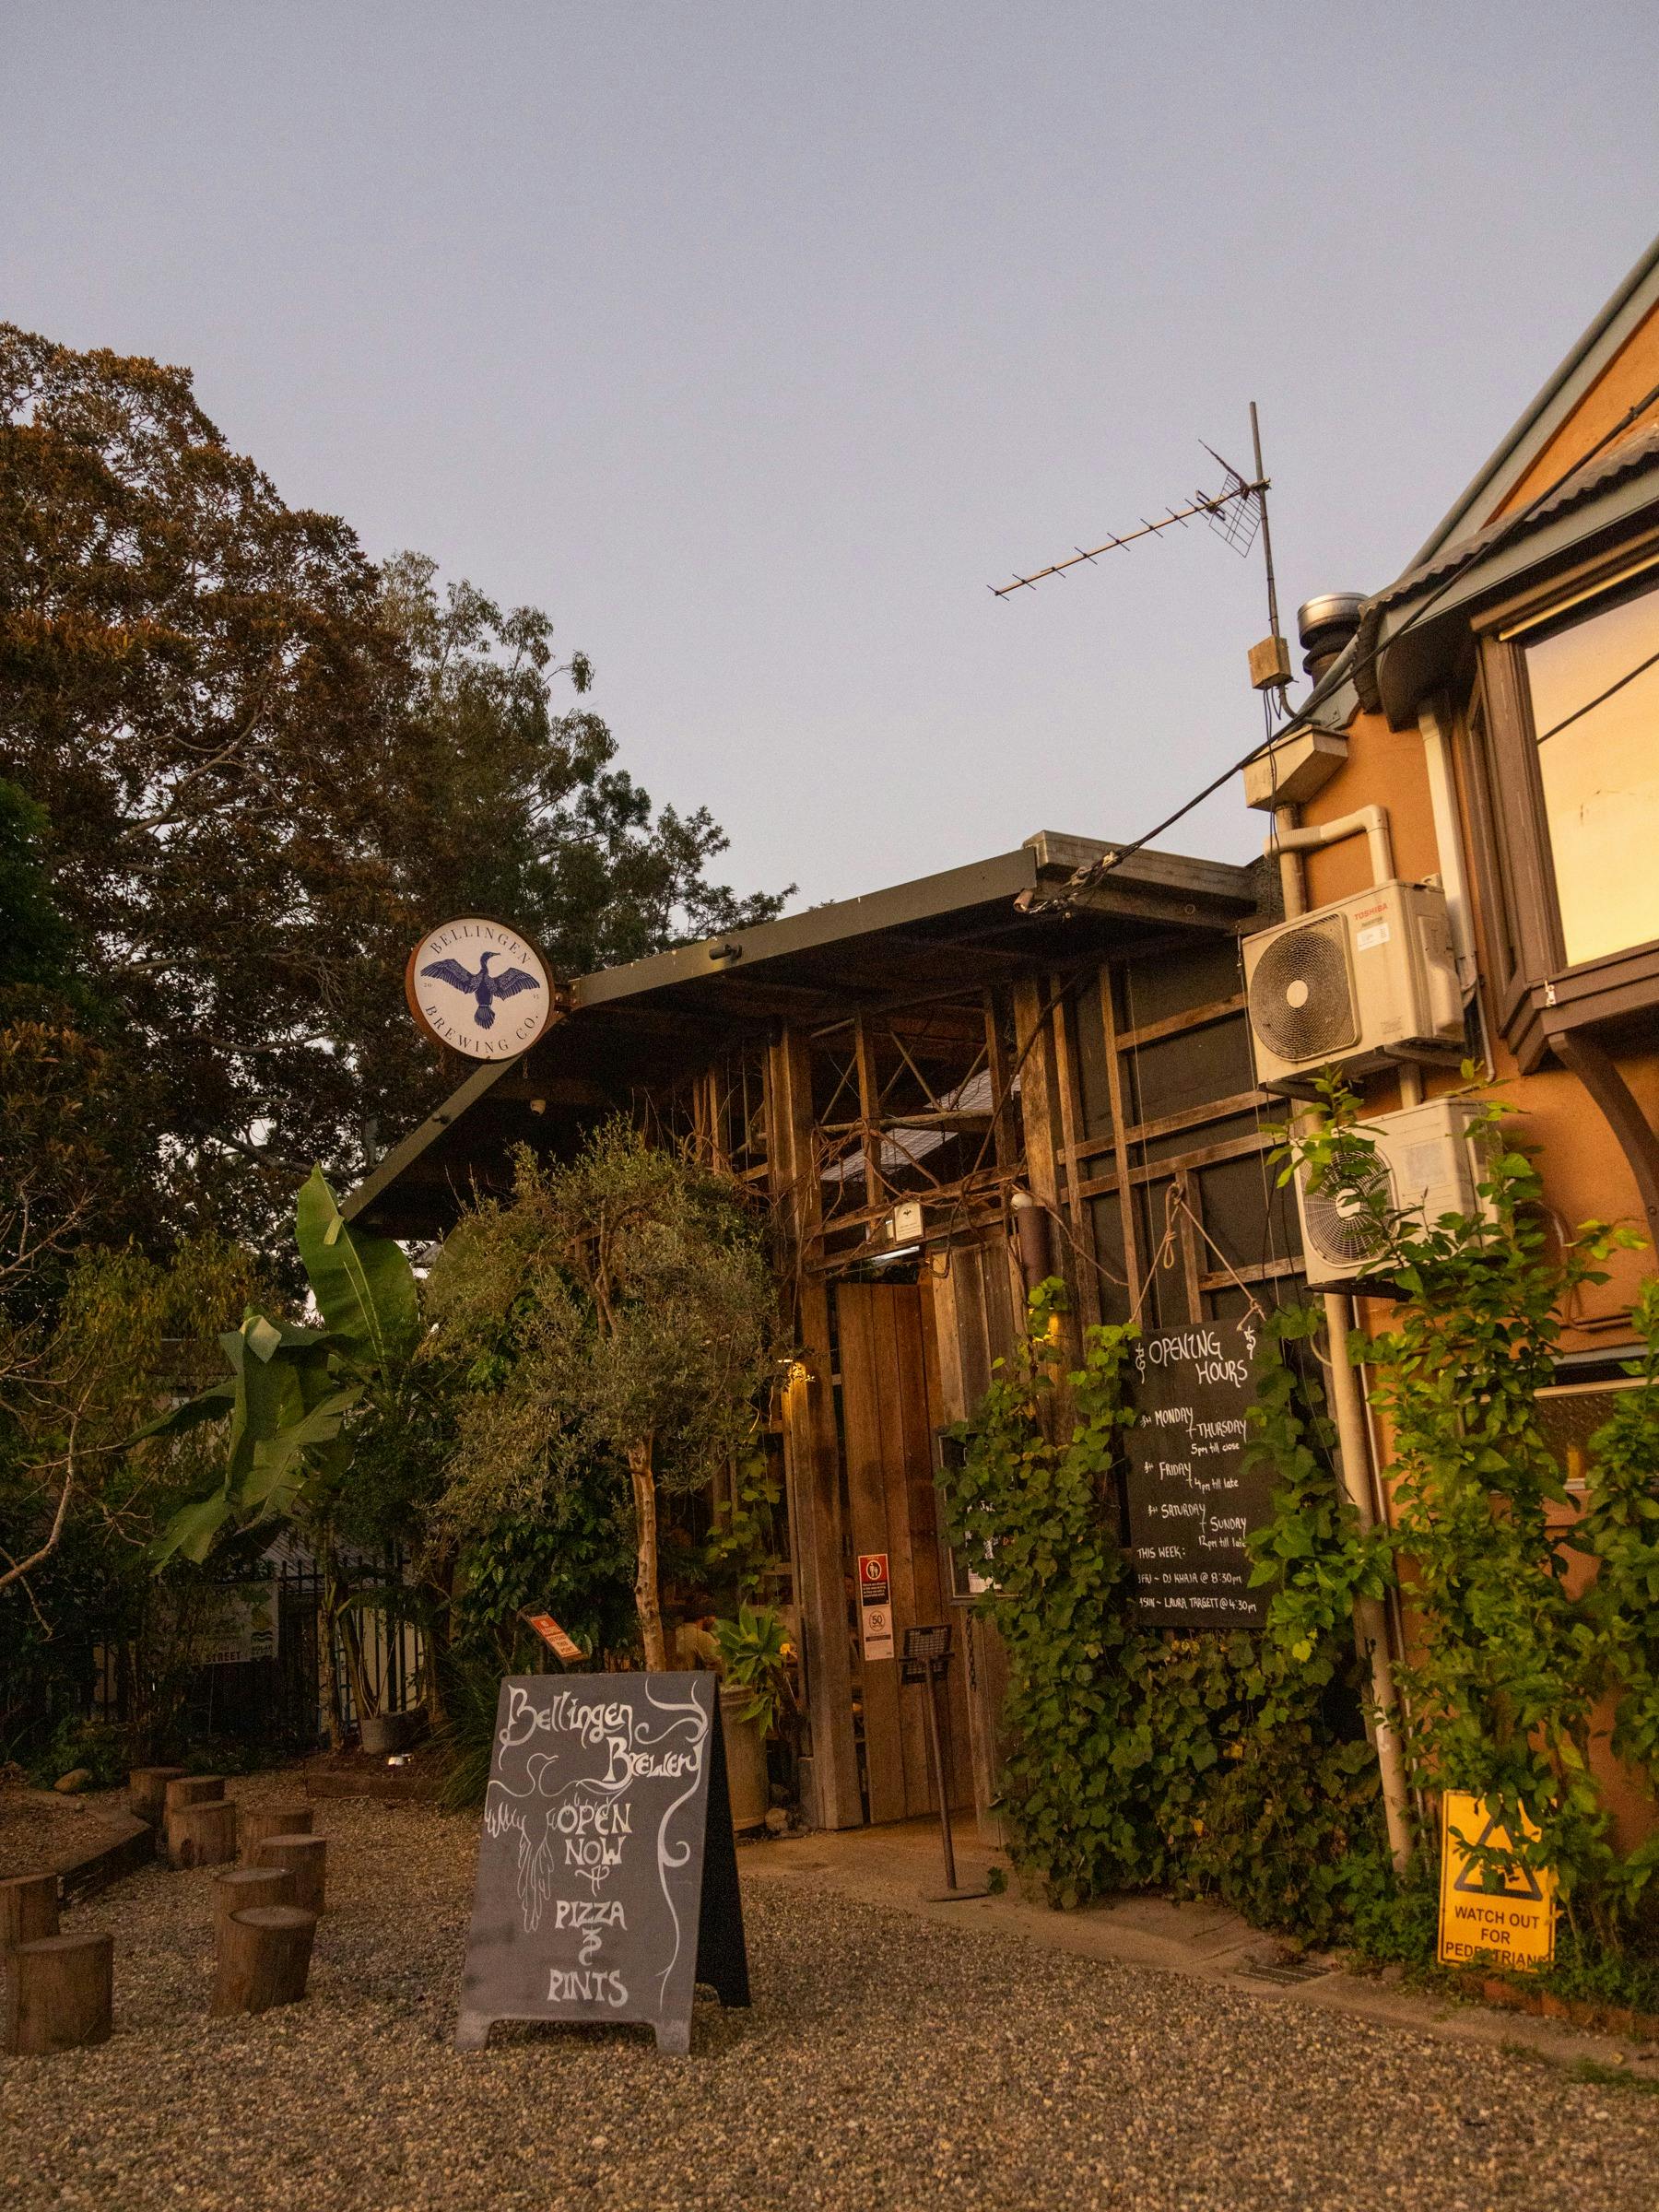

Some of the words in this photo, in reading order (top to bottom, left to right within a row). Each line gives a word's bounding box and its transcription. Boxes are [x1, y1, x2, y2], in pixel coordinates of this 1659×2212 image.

[1354, 902, 1388, 920] TOSHIBA
[429, 925, 531, 965] BELLINGEN
[425, 1005, 509, 1054] BREWING
[515, 1014, 539, 1041] CO.
[1148, 1329, 1223, 1367] OPENING
[1194, 1359, 1248, 1388] HOURS
[1154, 1406, 1194, 1435] MONDAY
[1196, 1419, 1247, 1443] THURSDAY
[1191, 1443, 1208, 1456] 5pm
[1209, 1442, 1220, 1453] till
[1222, 1442, 1240, 1452] close
[1159, 1462, 1191, 1485] FRIDAY
[1194, 1477, 1211, 1494] 4pm
[1212, 1478, 1222, 1490] till
[1224, 1477, 1240, 1488] late
[1161, 1503, 1206, 1528] SATURDAY
[1210, 1516, 1247, 1538] SUNDAY
[1136, 1547, 1156, 1559] THIS
[1159, 1546, 1186, 1559] WEEK:
[1218, 1536, 1230, 1547] till
[1163, 1573, 1171, 1583] DJ
[1200, 1571, 1209, 1583] @
[1211, 1571, 1242, 1585] 8:30pm
[1164, 1597, 1187, 1609] LAURA
[872, 1615, 883, 1625] 50
[557, 1802, 633, 1836] OPEN
[564, 1835, 627, 1865] NOW
[554, 1900, 628, 1931] PIZZA
[1454, 1905, 1505, 1924] WATCH
[1509, 1912, 1540, 1929] OUT
[1481, 1927, 1511, 1945] FOR
[547, 1969, 629, 2008] PINTS
